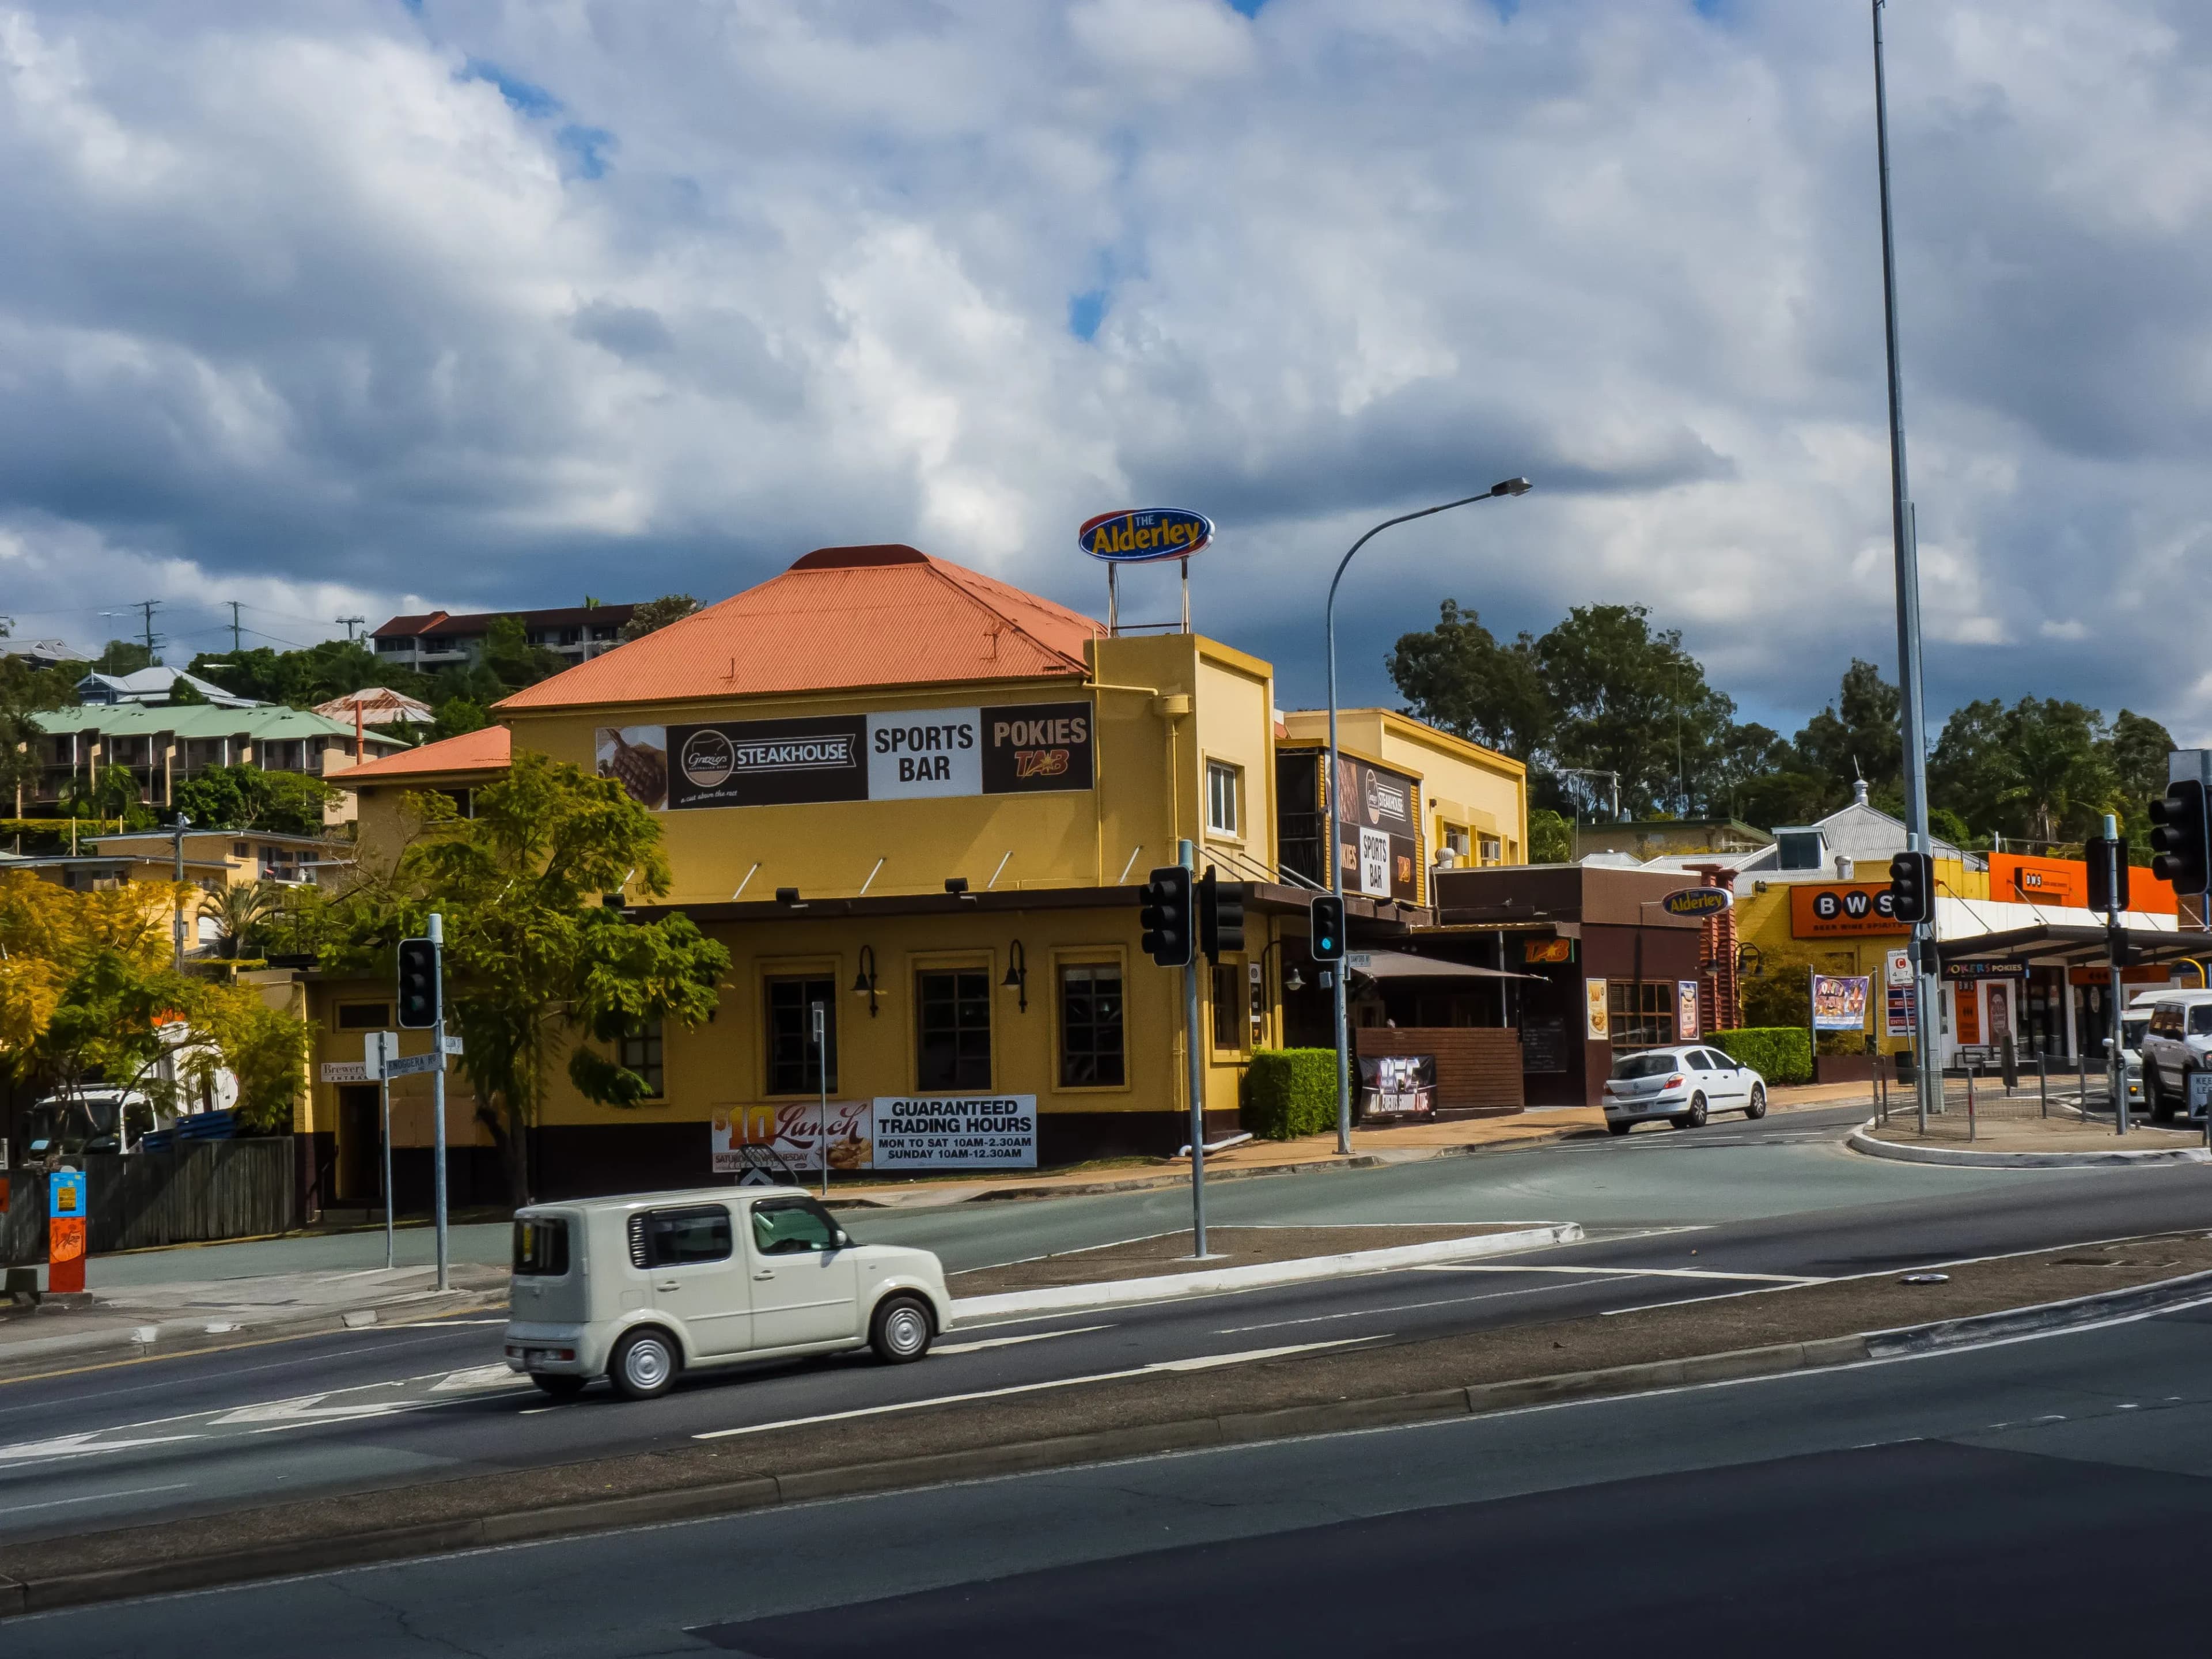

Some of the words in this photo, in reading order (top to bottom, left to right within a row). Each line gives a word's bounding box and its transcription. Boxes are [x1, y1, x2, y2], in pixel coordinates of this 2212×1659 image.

[1135, 516, 1155, 526] THE
[1092, 513, 1199, 554] Alderley
[874, 724, 974, 753] SPORTS
[994, 718, 1087, 747] POKIES
[688, 752, 728, 767] Graziers
[737, 744, 847, 764] STEAKHOUSE
[1014, 749, 1070, 778] TAB
[899, 756, 951, 782] BAR
[1342, 843, 1357, 870] KIES
[1363, 835, 1387, 863] SPORTS
[1369, 864, 1382, 889] BAR
[1671, 891, 1722, 913] Alderley
[1820, 895, 1893, 914] BWS
[1524, 940, 1570, 963] TAB
[323, 1064, 364, 1074] Brewery
[389, 1058, 425, 1070] ENOGGERA
[429, 1055, 436, 1065] RD
[892, 1100, 1018, 1116] GUARANTEED
[777, 1104, 867, 1149] Lunch
[878, 1118, 960, 1133] TRADING
[967, 1117, 1032, 1132] HOURS
[878, 1139, 904, 1148] MON
[909, 1138, 924, 1147] TO
[927, 1138, 949, 1147] SAT
[953, 1138, 1031, 1147] 10AM-2.30AM
[888, 1149, 934, 1159] SUNDAY
[938, 1149, 1021, 1158] 10AM-12.30AM
